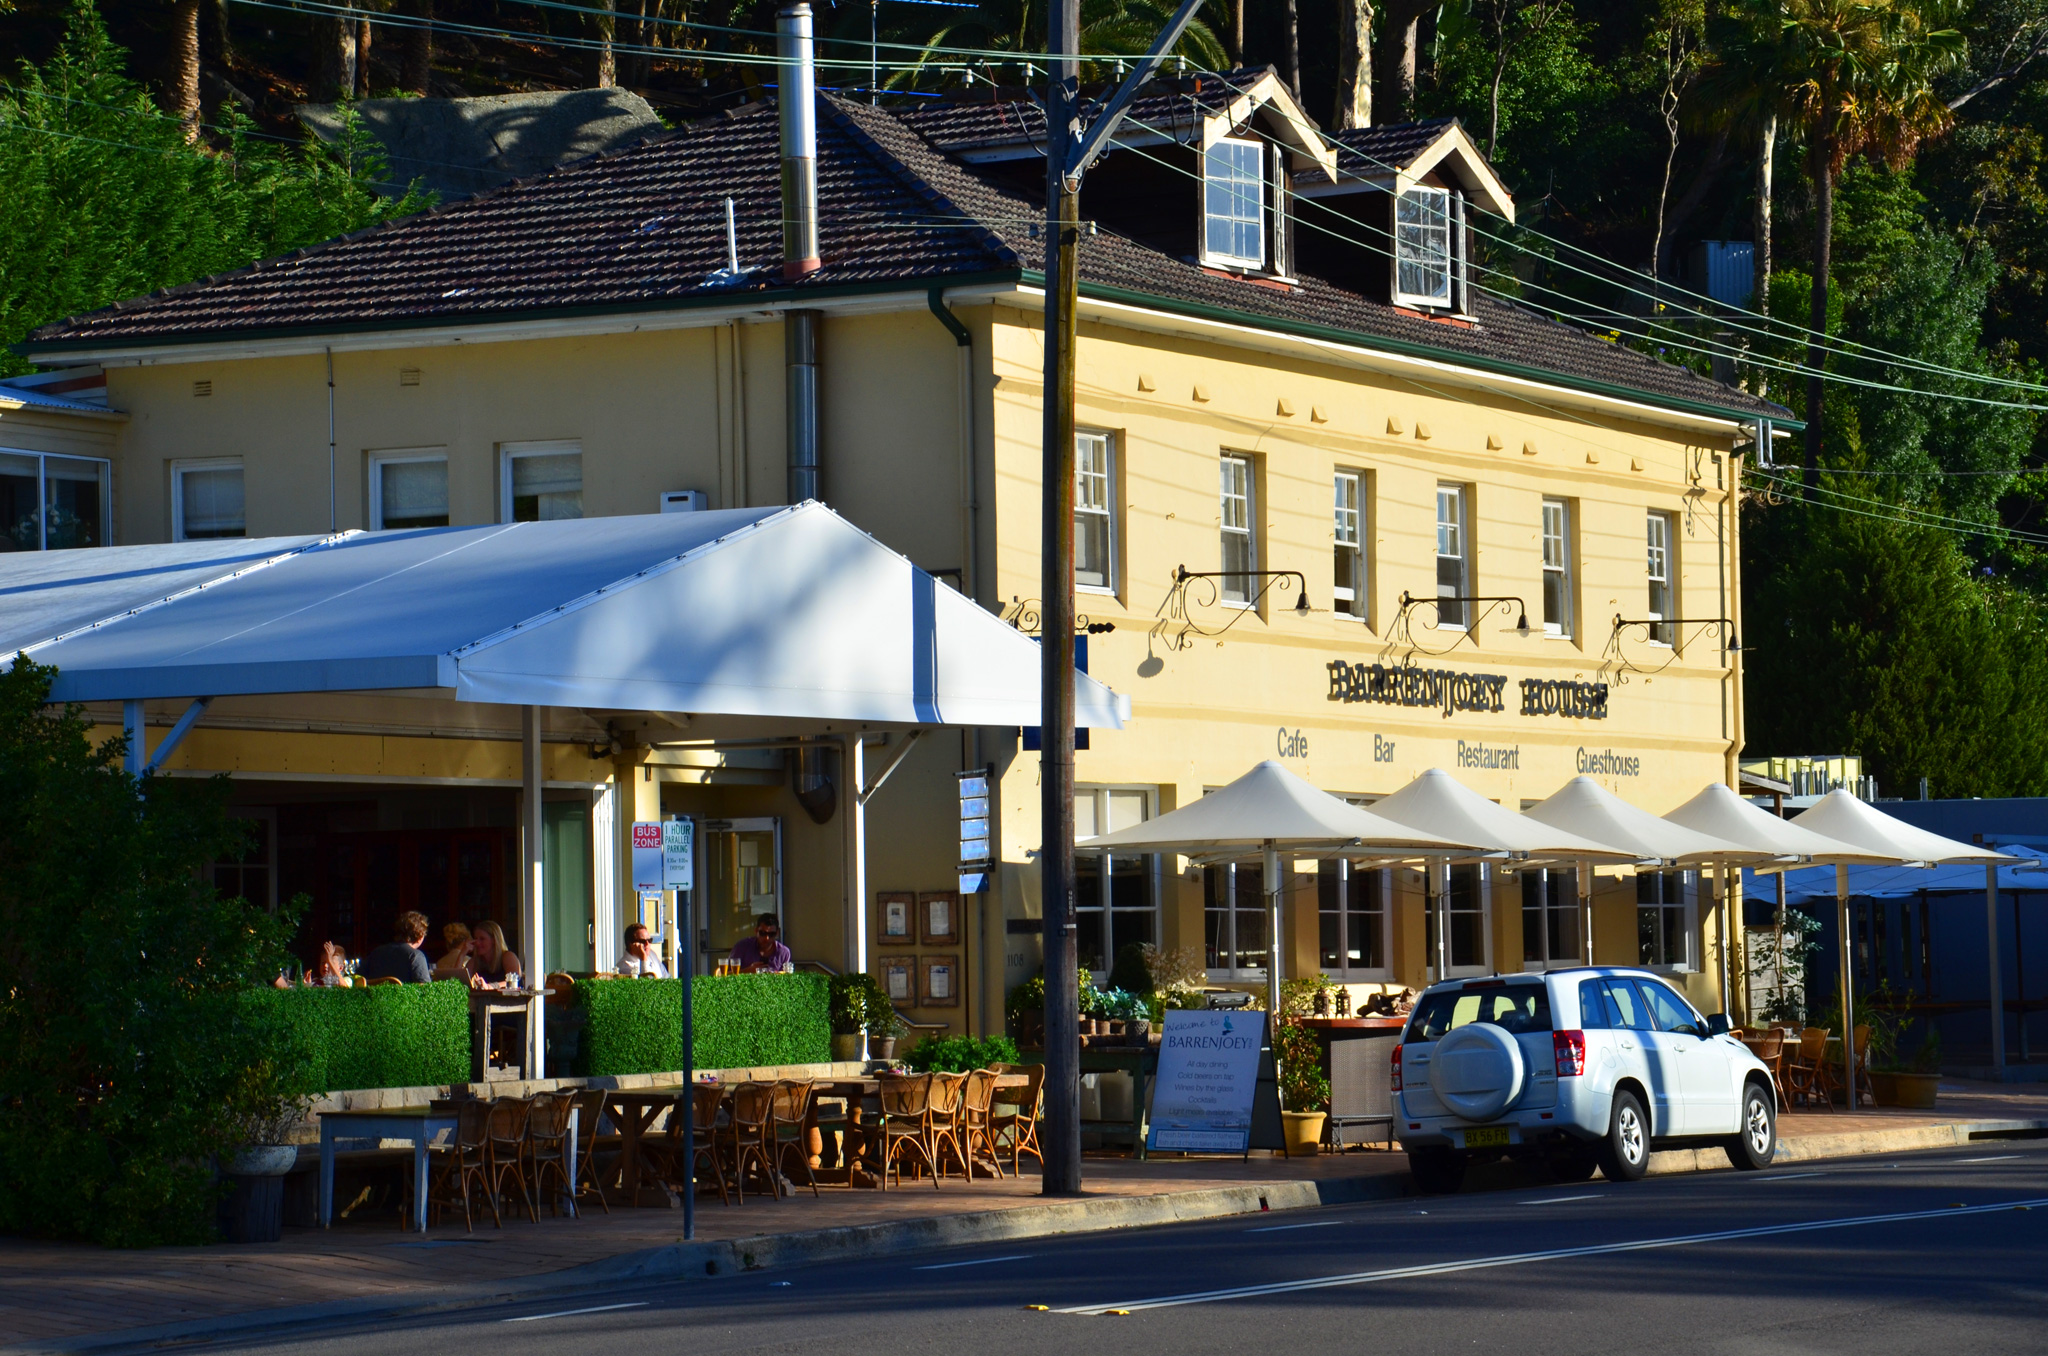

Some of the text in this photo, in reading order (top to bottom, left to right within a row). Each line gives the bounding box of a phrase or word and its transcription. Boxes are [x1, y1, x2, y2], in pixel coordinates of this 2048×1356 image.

[1328, 660, 1608, 719] BARRENJOEY HOUSE
[1277, 726, 1308, 758] Cafe
[1374, 733, 1395, 762] Bar
[1457, 740, 1519, 770] Restaurant
[1576, 746, 1639, 776] Guesthouse
[637, 827, 657, 836] BUS
[671, 825, 691, 835] HOUR
[634, 838, 660, 847] ZONE
[665, 835, 690, 844] PARALLEL
[667, 845, 688, 853] PARKING
[1007, 953, 1024, 967] 1108
[1166, 1018, 1219, 1032] Welcome to
[1168, 1035, 1249, 1051] BARRENJOEY
[1196, 1060, 1208, 1069] day
[1209, 1061, 1229, 1070] dining
[1177, 1071, 1193, 1080] Cold
[1194, 1072, 1213, 1080] beers
[1224, 1073, 1235, 1081] tap
[1196, 1084, 1205, 1092] by
[1216, 1085, 1234, 1093] glass
[1188, 1096, 1217, 1104] Cocktails
[1168, 1107, 1185, 1116] Light
[1466, 1129, 1507, 1143] BX 56 FH
